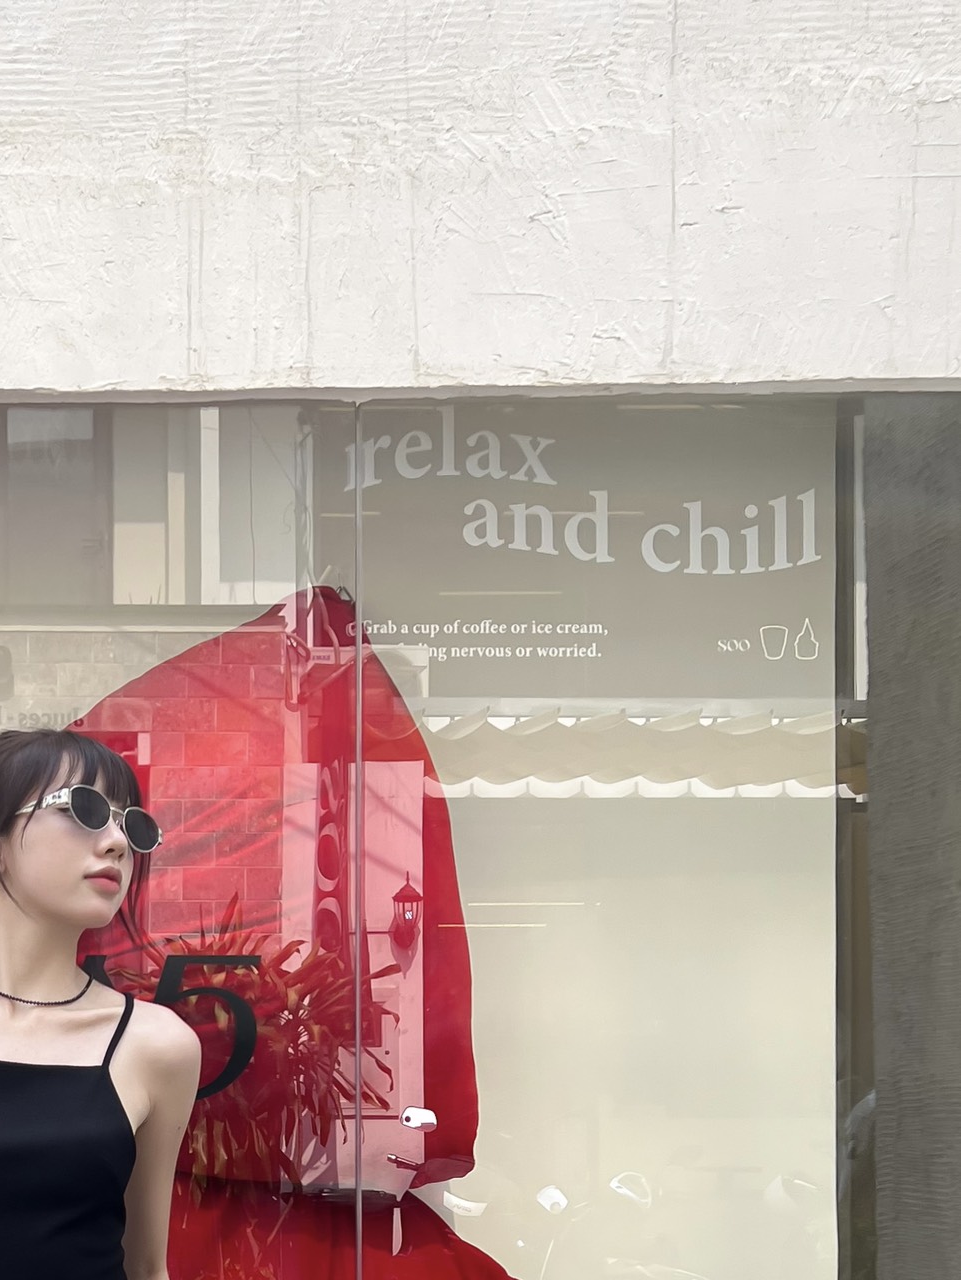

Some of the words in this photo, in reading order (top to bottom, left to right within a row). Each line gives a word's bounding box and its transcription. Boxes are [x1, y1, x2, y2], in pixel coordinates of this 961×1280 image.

[359, 405, 557, 486] relax
[462, 490, 615, 563] and
[641, 488, 822, 575] chill
[361, 619, 397, 635] Grab
[400, 624, 409, 635] a
[413, 624, 440, 638] cup
[443, 619, 461, 635] of
[462, 619, 507, 635] coffee
[511, 624, 528, 635] or
[531, 619, 553, 635] ice
[556, 624, 609, 637] cream,
[450, 646, 512, 658] nervous
[515, 646, 533, 658] or
[537, 642, 602, 658] worried.
